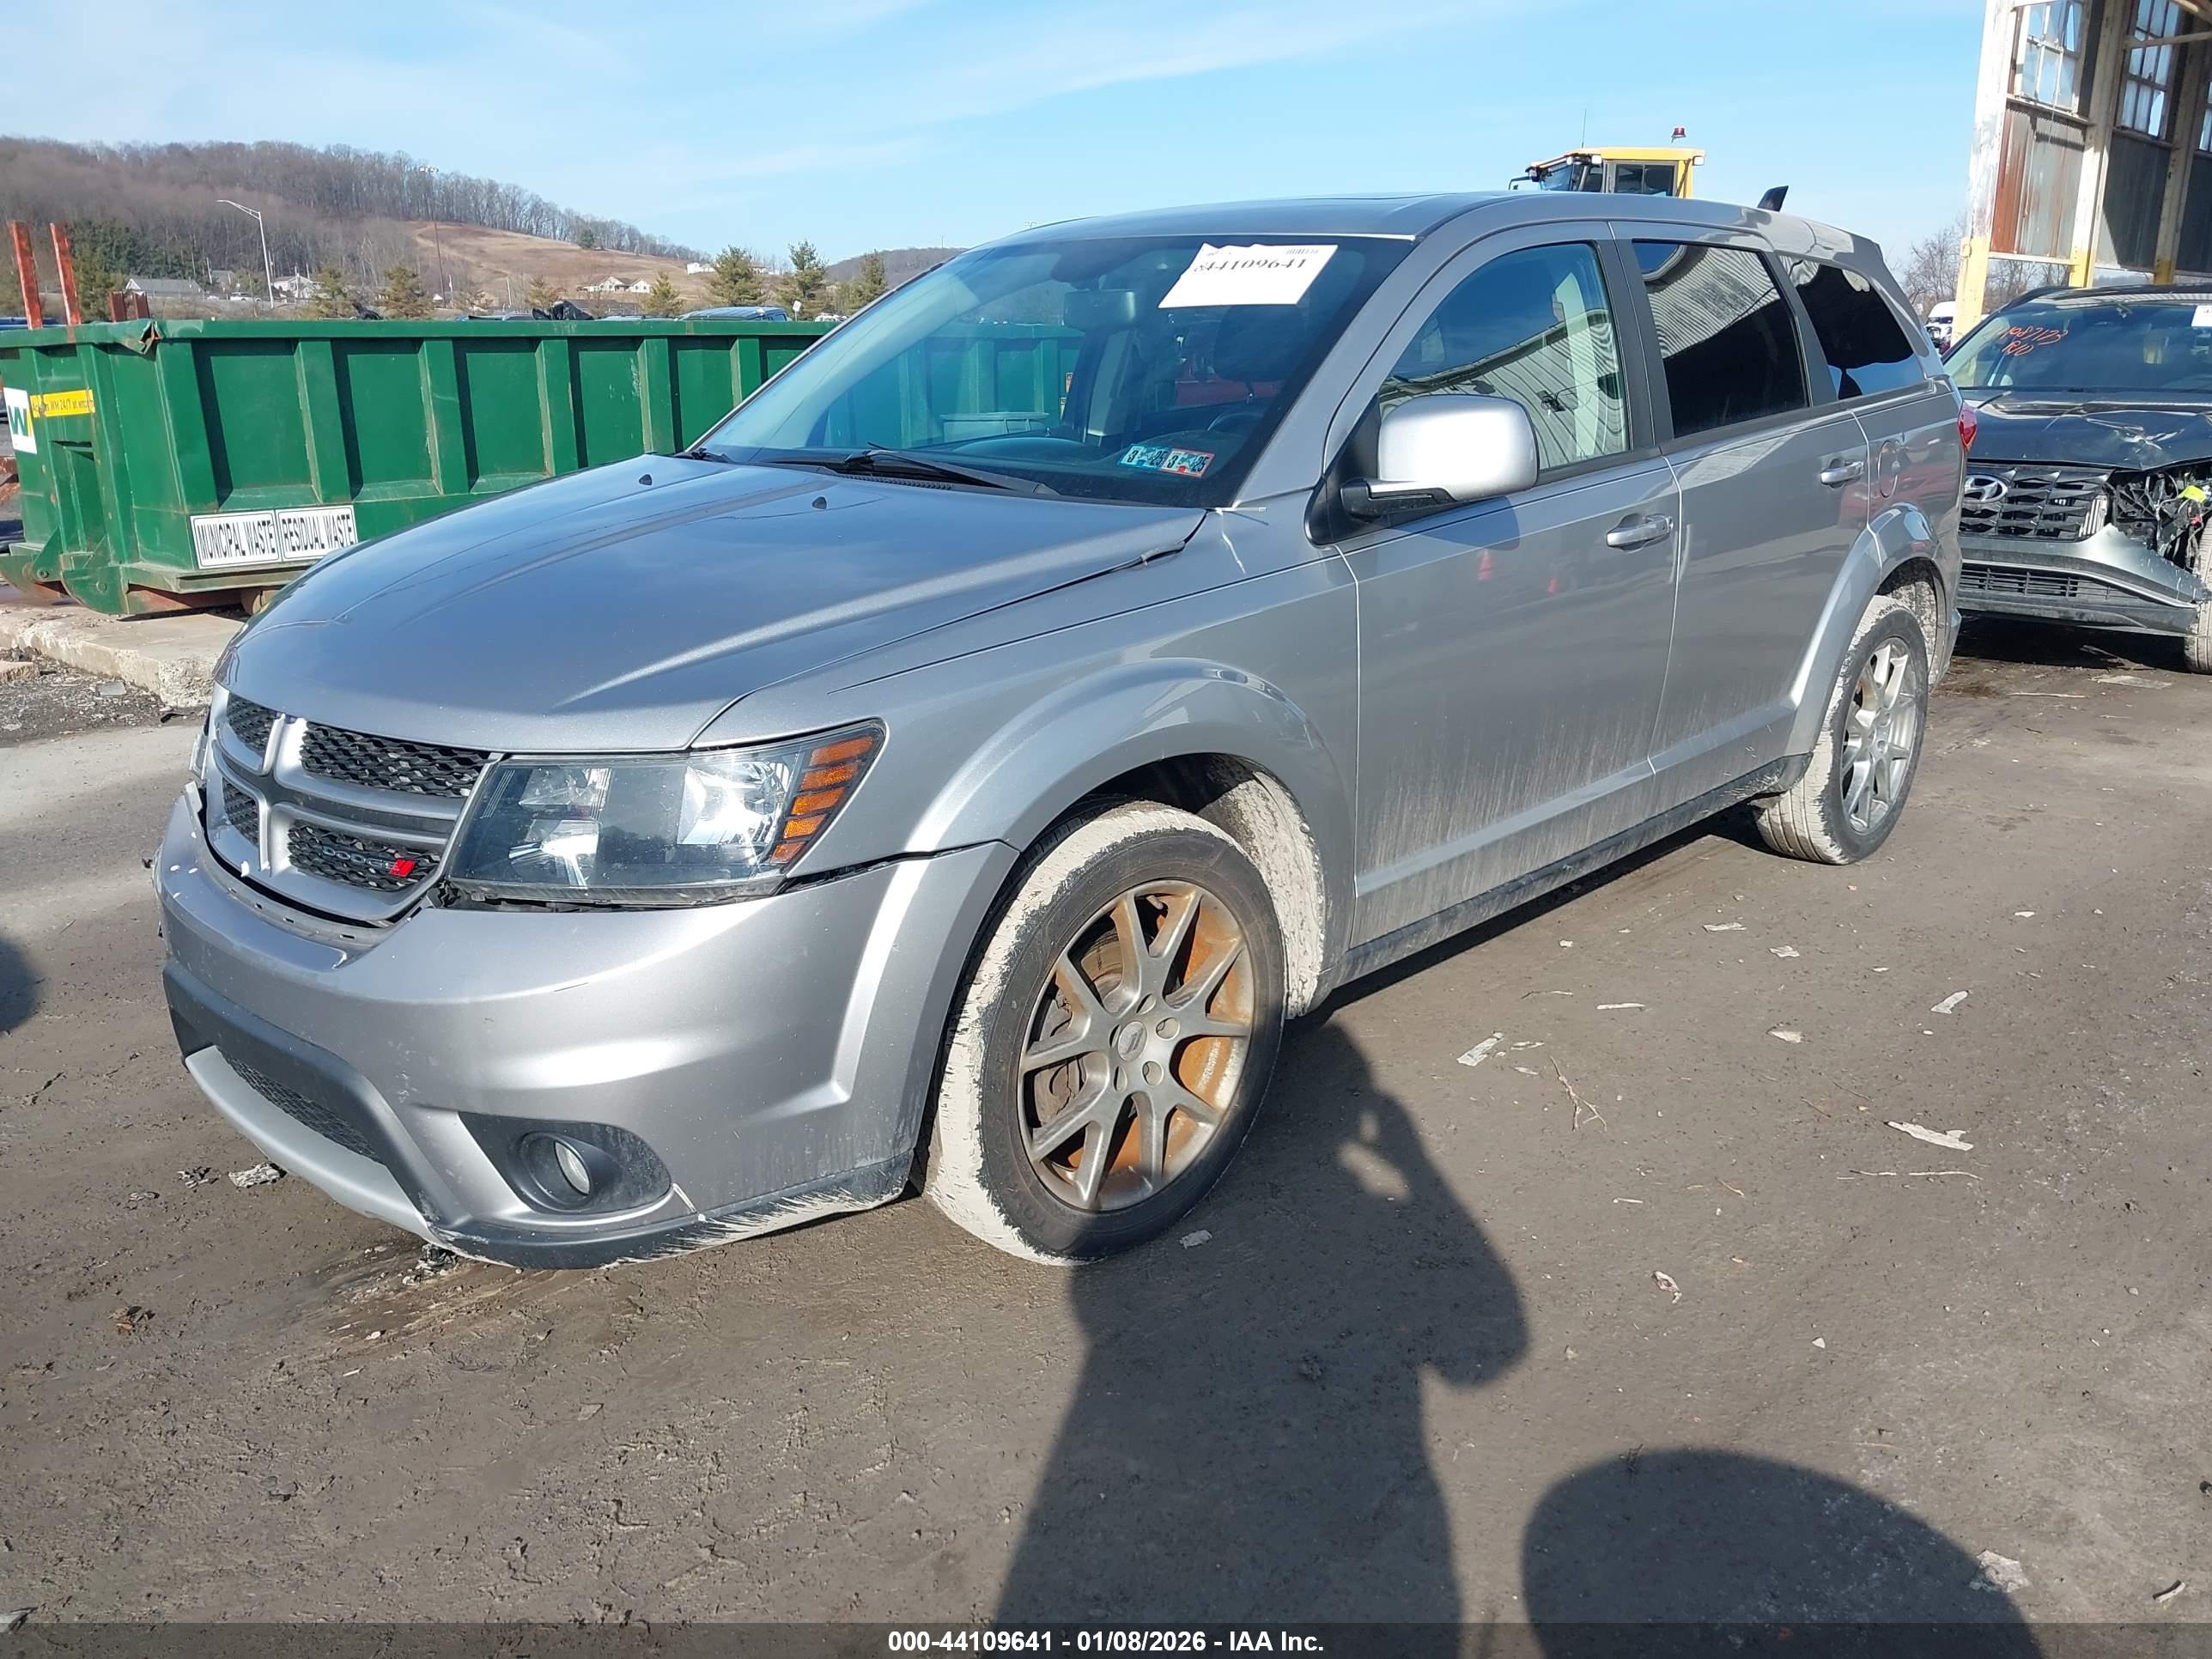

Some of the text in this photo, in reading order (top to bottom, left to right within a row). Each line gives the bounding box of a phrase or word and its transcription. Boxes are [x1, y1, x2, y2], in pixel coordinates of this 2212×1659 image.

[1127, 450, 1139, 463] 3
[1168, 455, 1179, 469] 3
[1191, 455, 1210, 472] 25
[198, 520, 276, 559] MUNICIPAL WASTE
[282, 514, 355, 552] RESIDUAL WASTE
